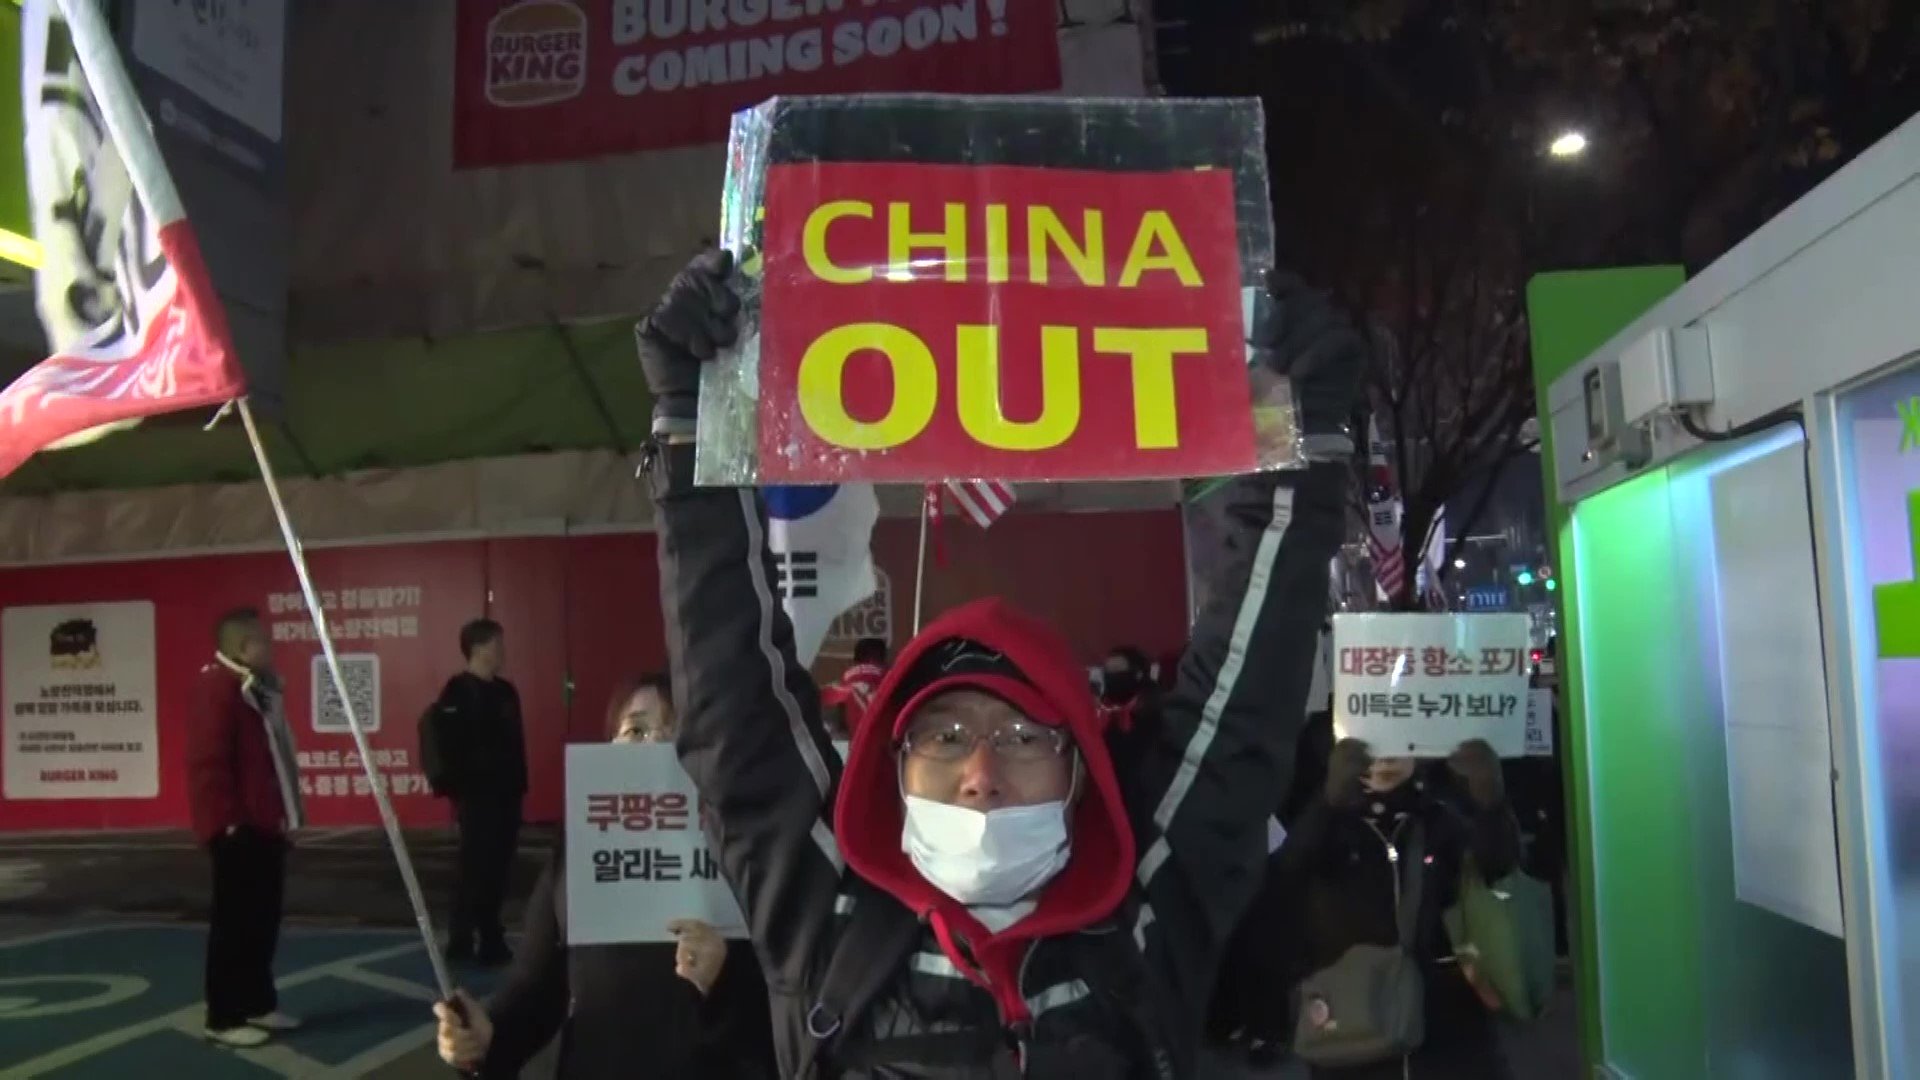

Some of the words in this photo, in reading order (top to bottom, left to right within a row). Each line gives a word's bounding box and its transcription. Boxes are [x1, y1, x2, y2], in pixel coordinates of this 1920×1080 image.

[491, 32, 581, 53] BURGER
[491, 53, 581, 82] KING
[612, 29, 823, 95] COMING
[803, 201, 1204, 287] CHINA
[798, 323, 1208, 450] OUT
[829, 610, 887, 637] ING
[1422, 646, 1473, 677] 항소
[1479, 648, 1524, 677] 포기
[1348, 692, 1412, 717] 이득은
[1418, 693, 1461, 717] 누가
[1466, 693, 1517, 717] 보나?
[344, 749, 408, 768] 스하고
[587, 793, 689, 831] 쿠팡은
[593, 848, 682, 882] 알리는
